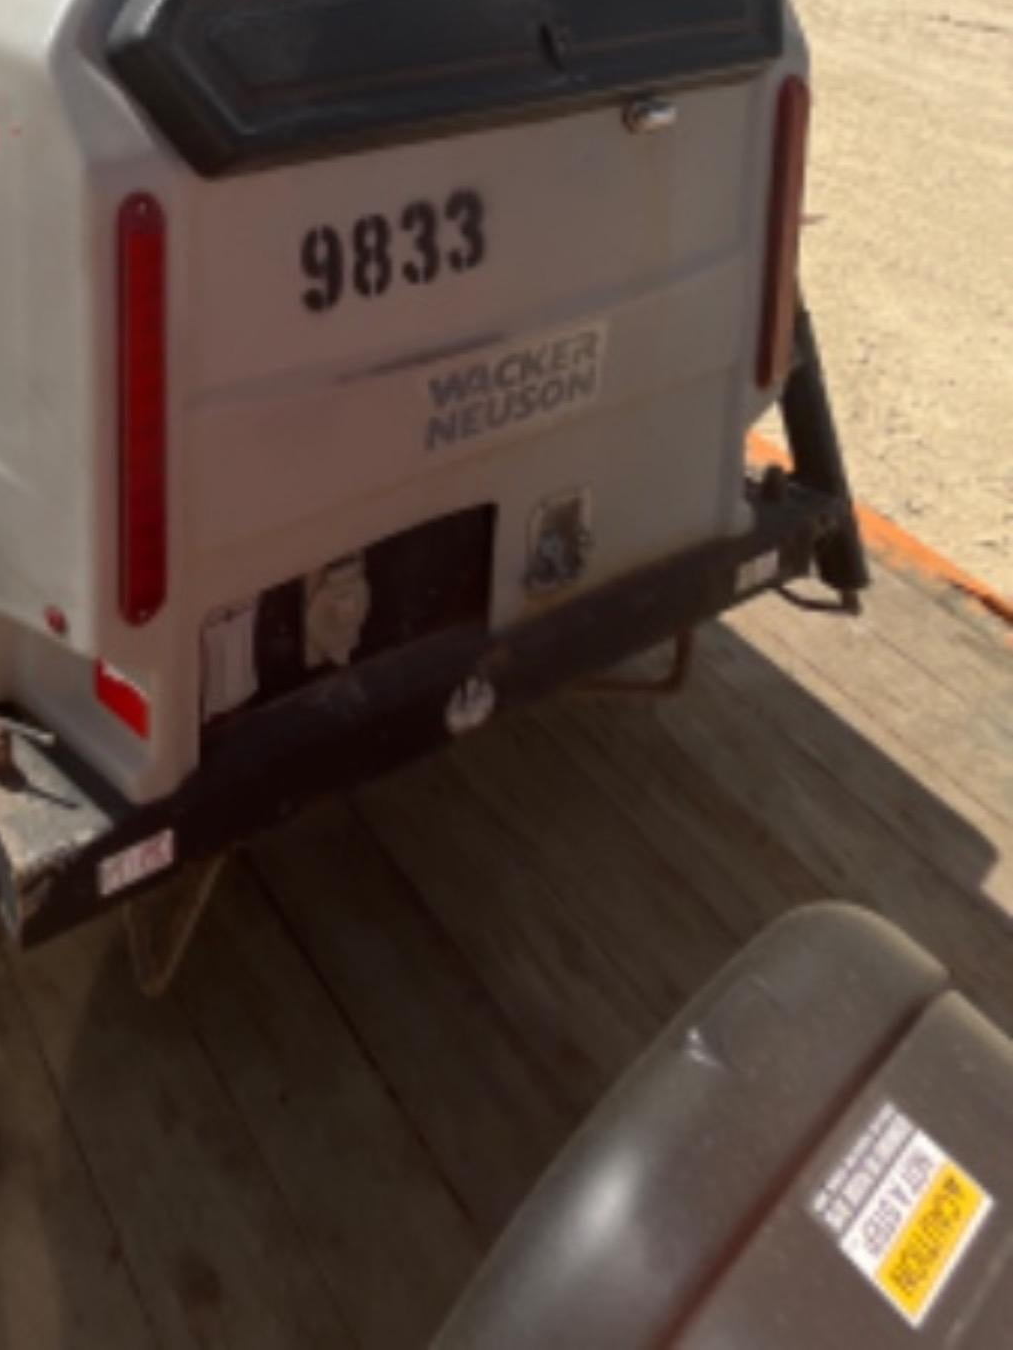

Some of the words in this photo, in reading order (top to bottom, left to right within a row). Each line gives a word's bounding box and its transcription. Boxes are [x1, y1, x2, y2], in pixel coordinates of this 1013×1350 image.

[300, 187, 486, 314] 9833
[423, 364, 597, 451] NEUSON
[426, 330, 599, 409] WACKER
[890, 1192, 962, 1297] CAUTION
